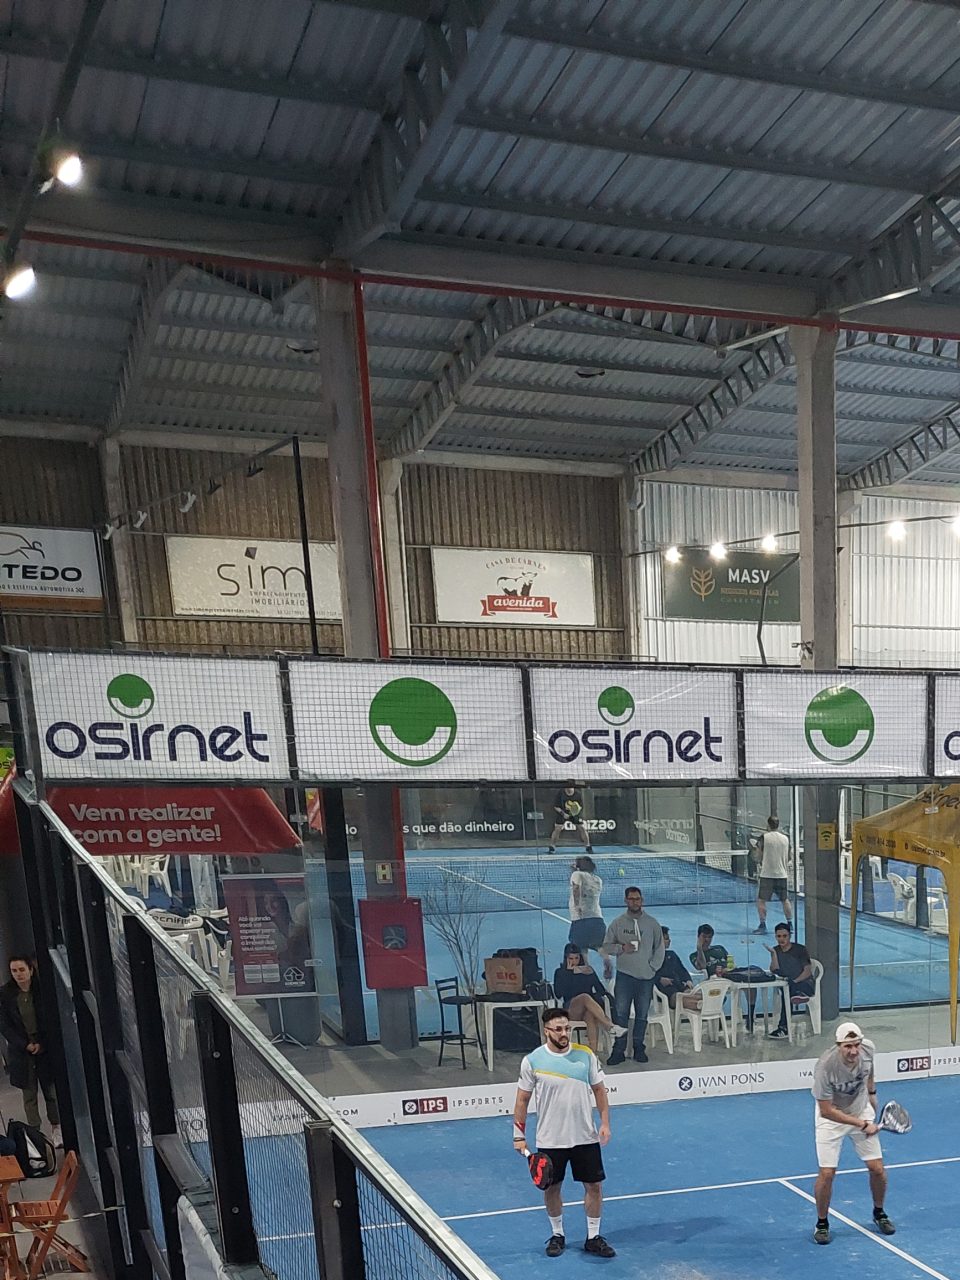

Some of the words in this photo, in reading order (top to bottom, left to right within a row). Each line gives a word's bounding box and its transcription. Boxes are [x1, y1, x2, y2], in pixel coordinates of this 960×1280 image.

[728, 568, 770, 584] MASV
[251, 599, 307, 607] IMOBILIÁRIO
[493, 597, 544, 608] avenida
[45, 711, 270, 763] osirnet
[548, 717, 723, 764] osirnet
[69, 804, 125, 822] Vem
[129, 803, 216, 822] realizar
[72, 828, 123, 844] com
[126, 829, 143, 843] a
[147, 825, 222, 847] gente!
[412, 824, 436, 836] que
[439, 822, 462, 834] dão
[464, 820, 515, 833] dinheiro
[912, 1058, 929, 1070] IPS
[698, 1075, 727, 1088] IVAN
[731, 1072, 765, 1085] PONS
[422, 1098, 444, 1112] IPS
[452, 1096, 504, 1108] IPSPORTS
